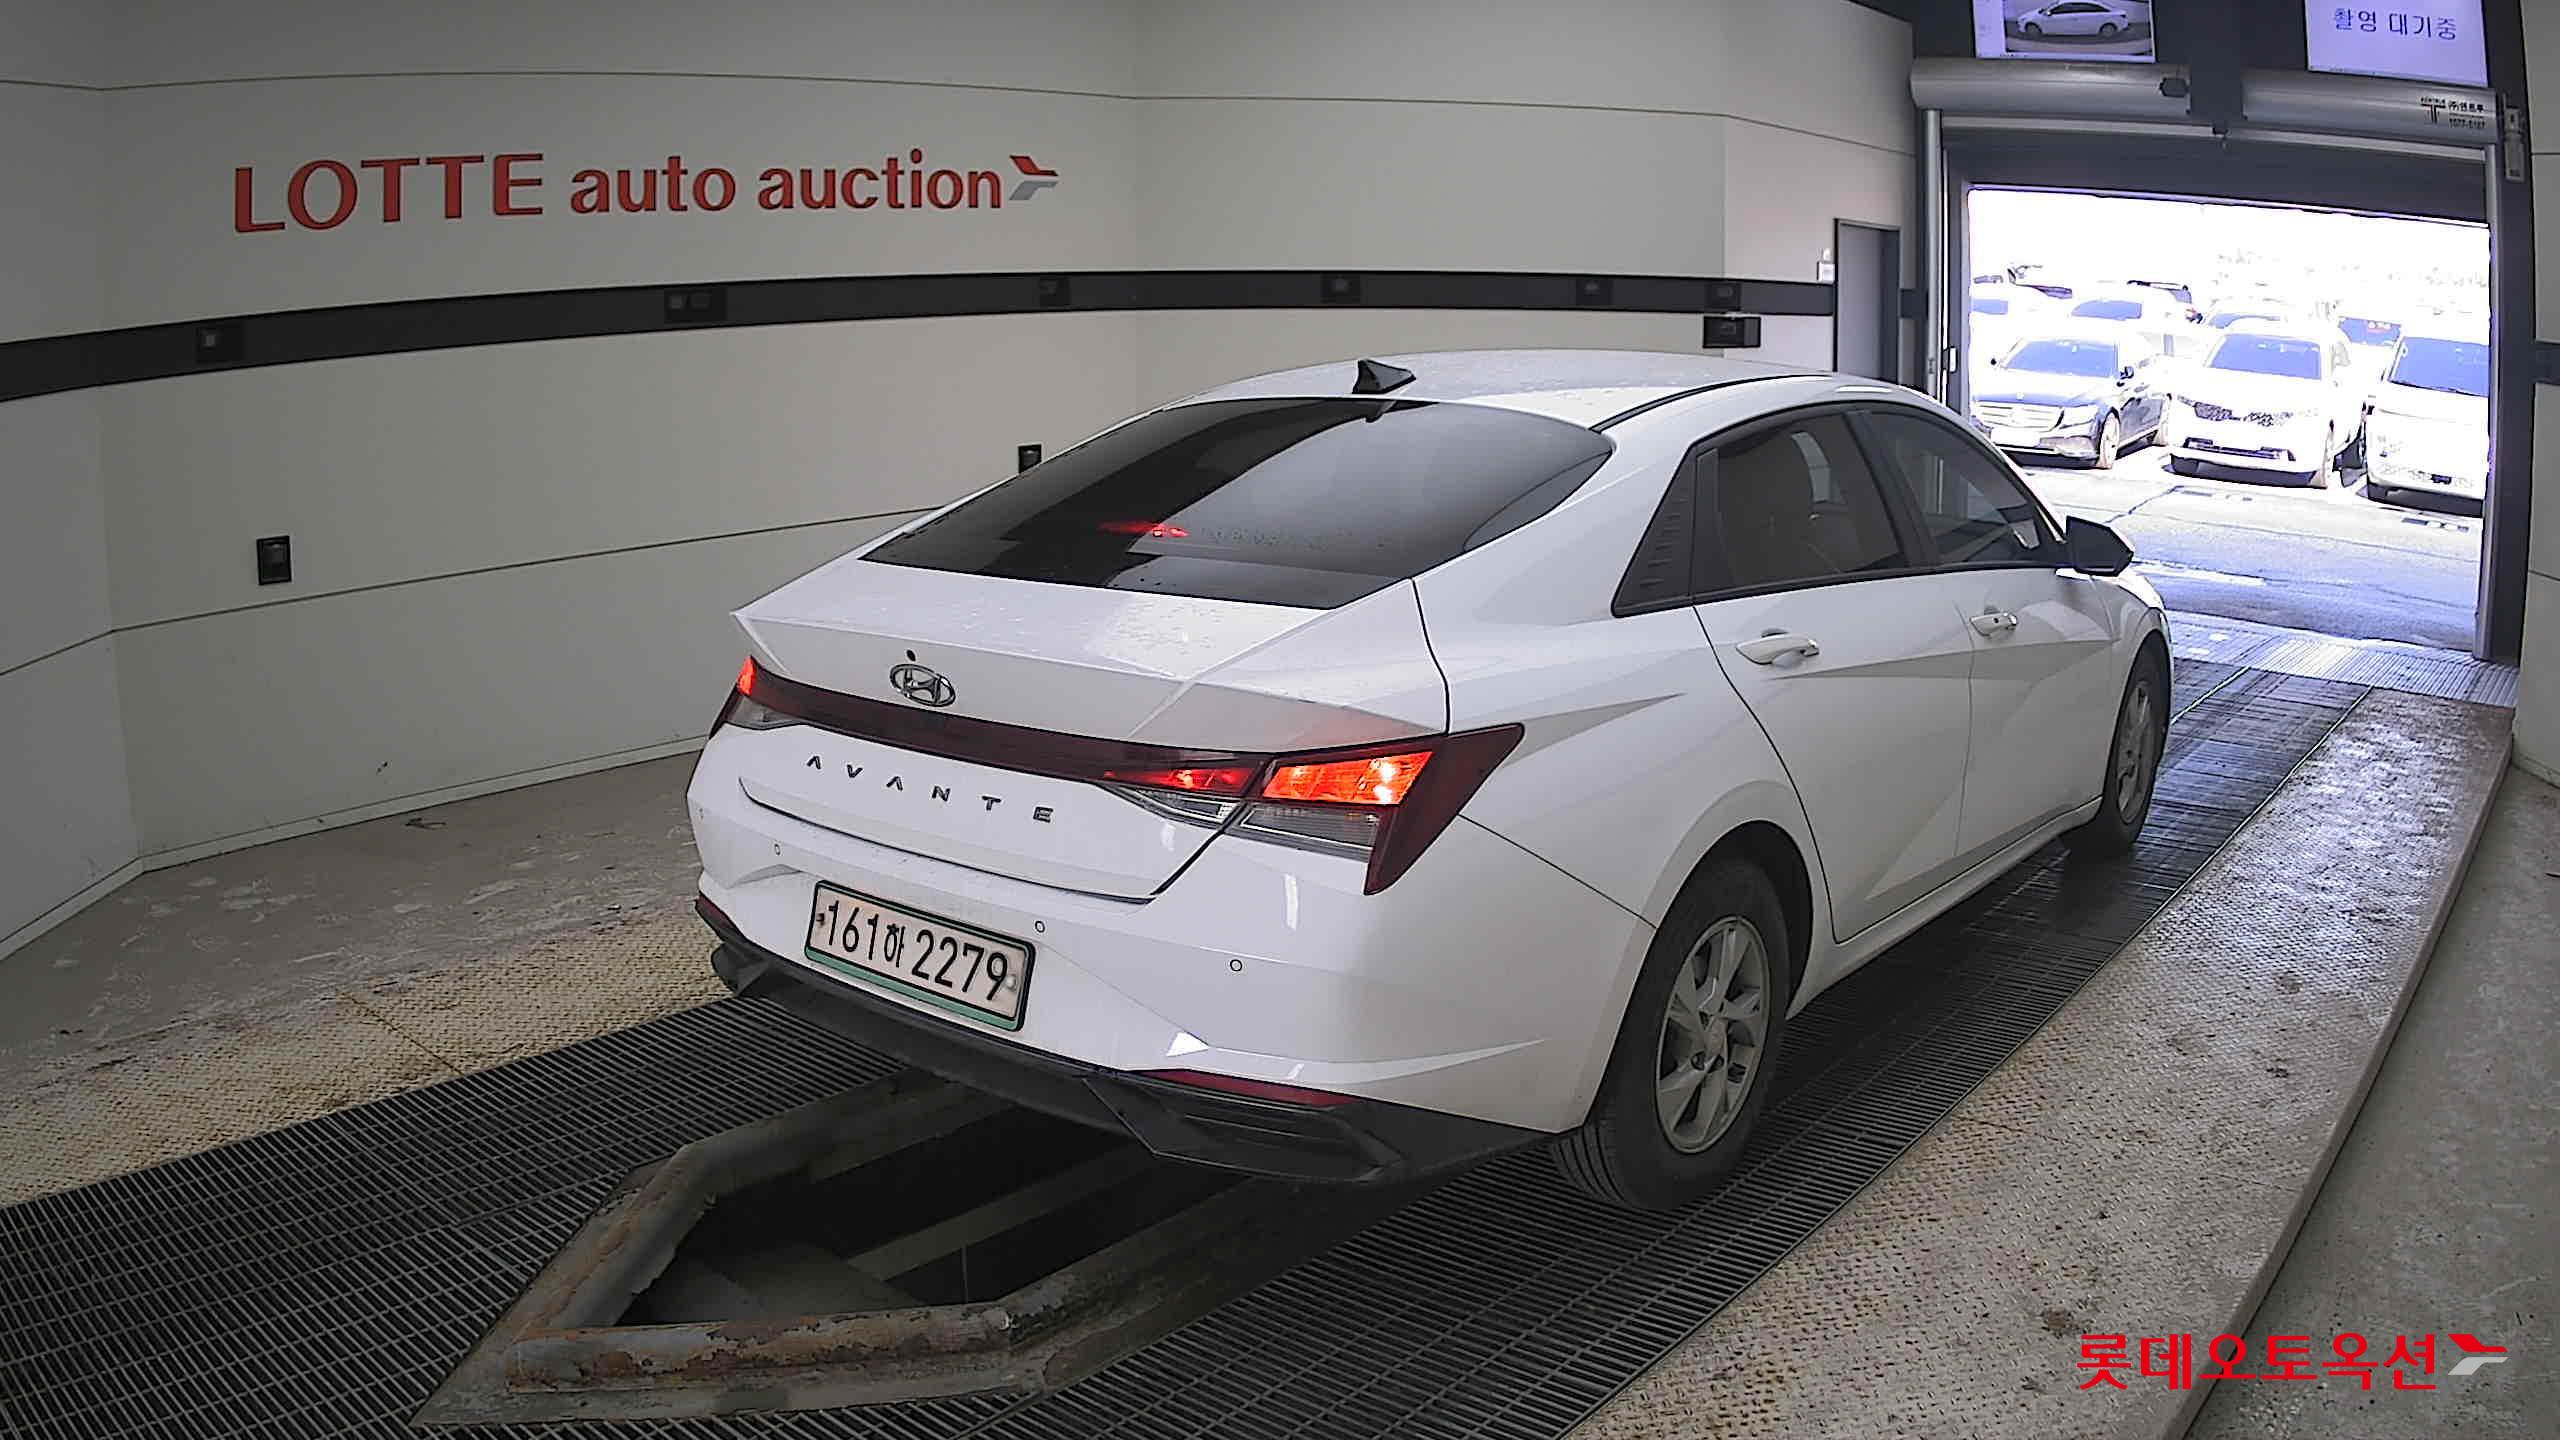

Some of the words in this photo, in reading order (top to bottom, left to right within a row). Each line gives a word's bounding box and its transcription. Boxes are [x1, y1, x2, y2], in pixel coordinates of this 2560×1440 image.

[2389, 12, 2457, 41] 대기중
[235, 154, 541, 233] LOTTE
[571, 157, 737, 214] auto
[757, 149, 1004, 209] auction
[806, 755, 1054, 823] AVANTE
